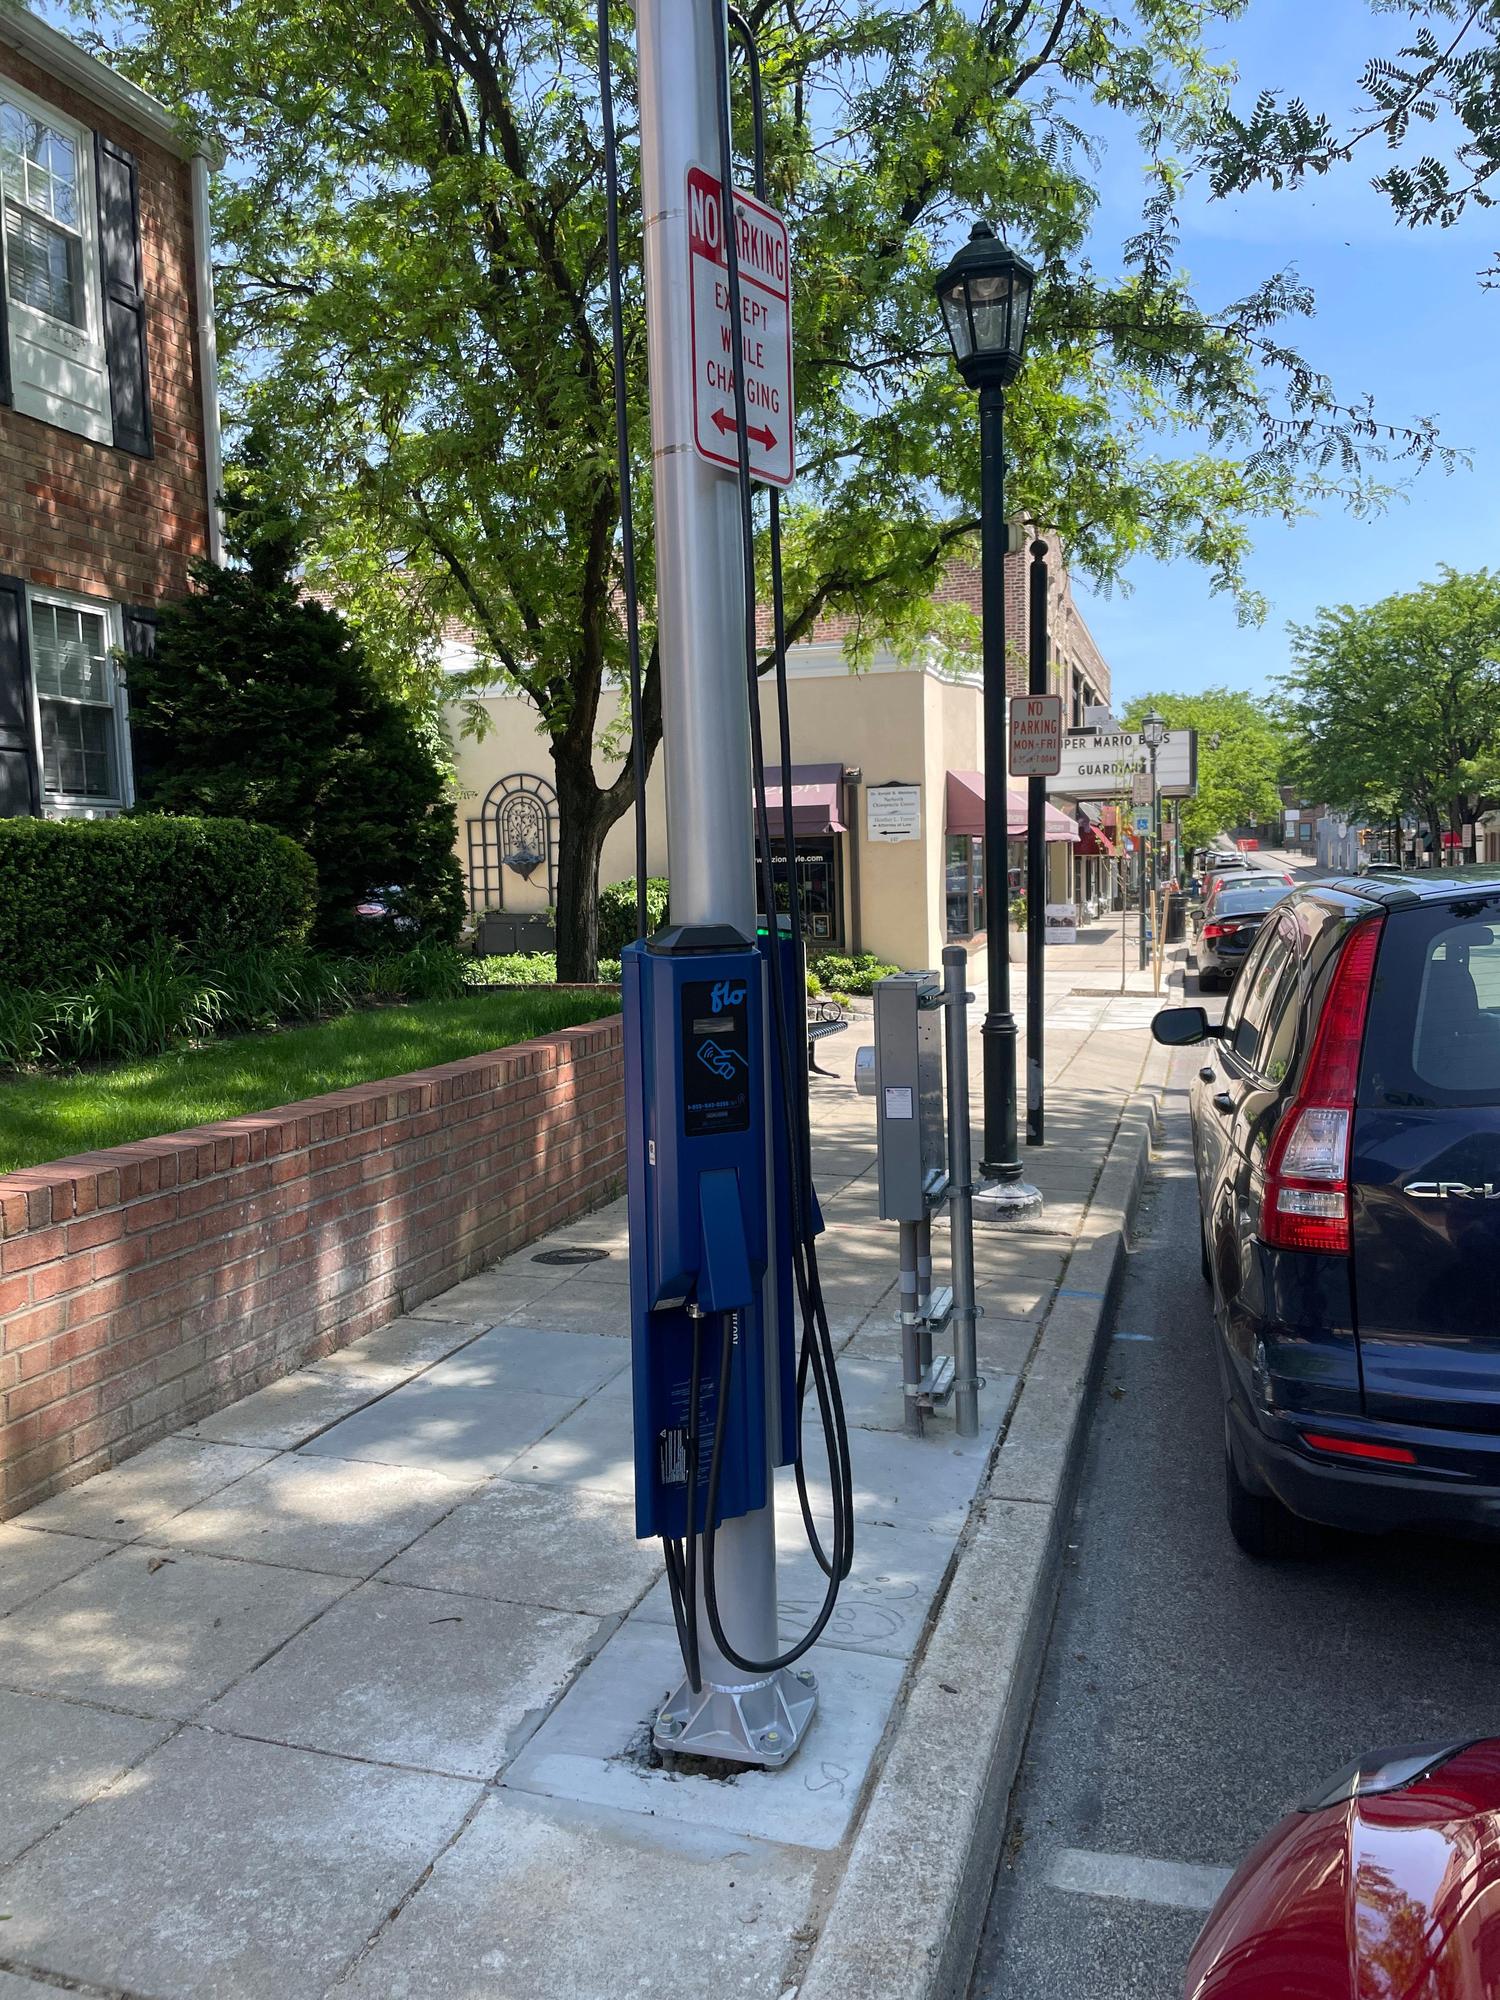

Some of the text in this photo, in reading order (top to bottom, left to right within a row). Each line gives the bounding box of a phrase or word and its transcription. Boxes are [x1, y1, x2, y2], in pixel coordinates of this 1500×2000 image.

[690, 183, 784, 281] NO ARKING
[715, 282, 769, 331] EXEPT
[720, 325, 765, 369] WILE
[707, 360, 780, 414] CHAGING
[1027, 701, 1043, 716] NO
[1013, 719, 1057, 735] PARKING
[1060, 733, 1170, 749] PER MARIO BS
[1013, 738, 1056, 750] MON-FRI
[711, 981, 747, 1013] flo
